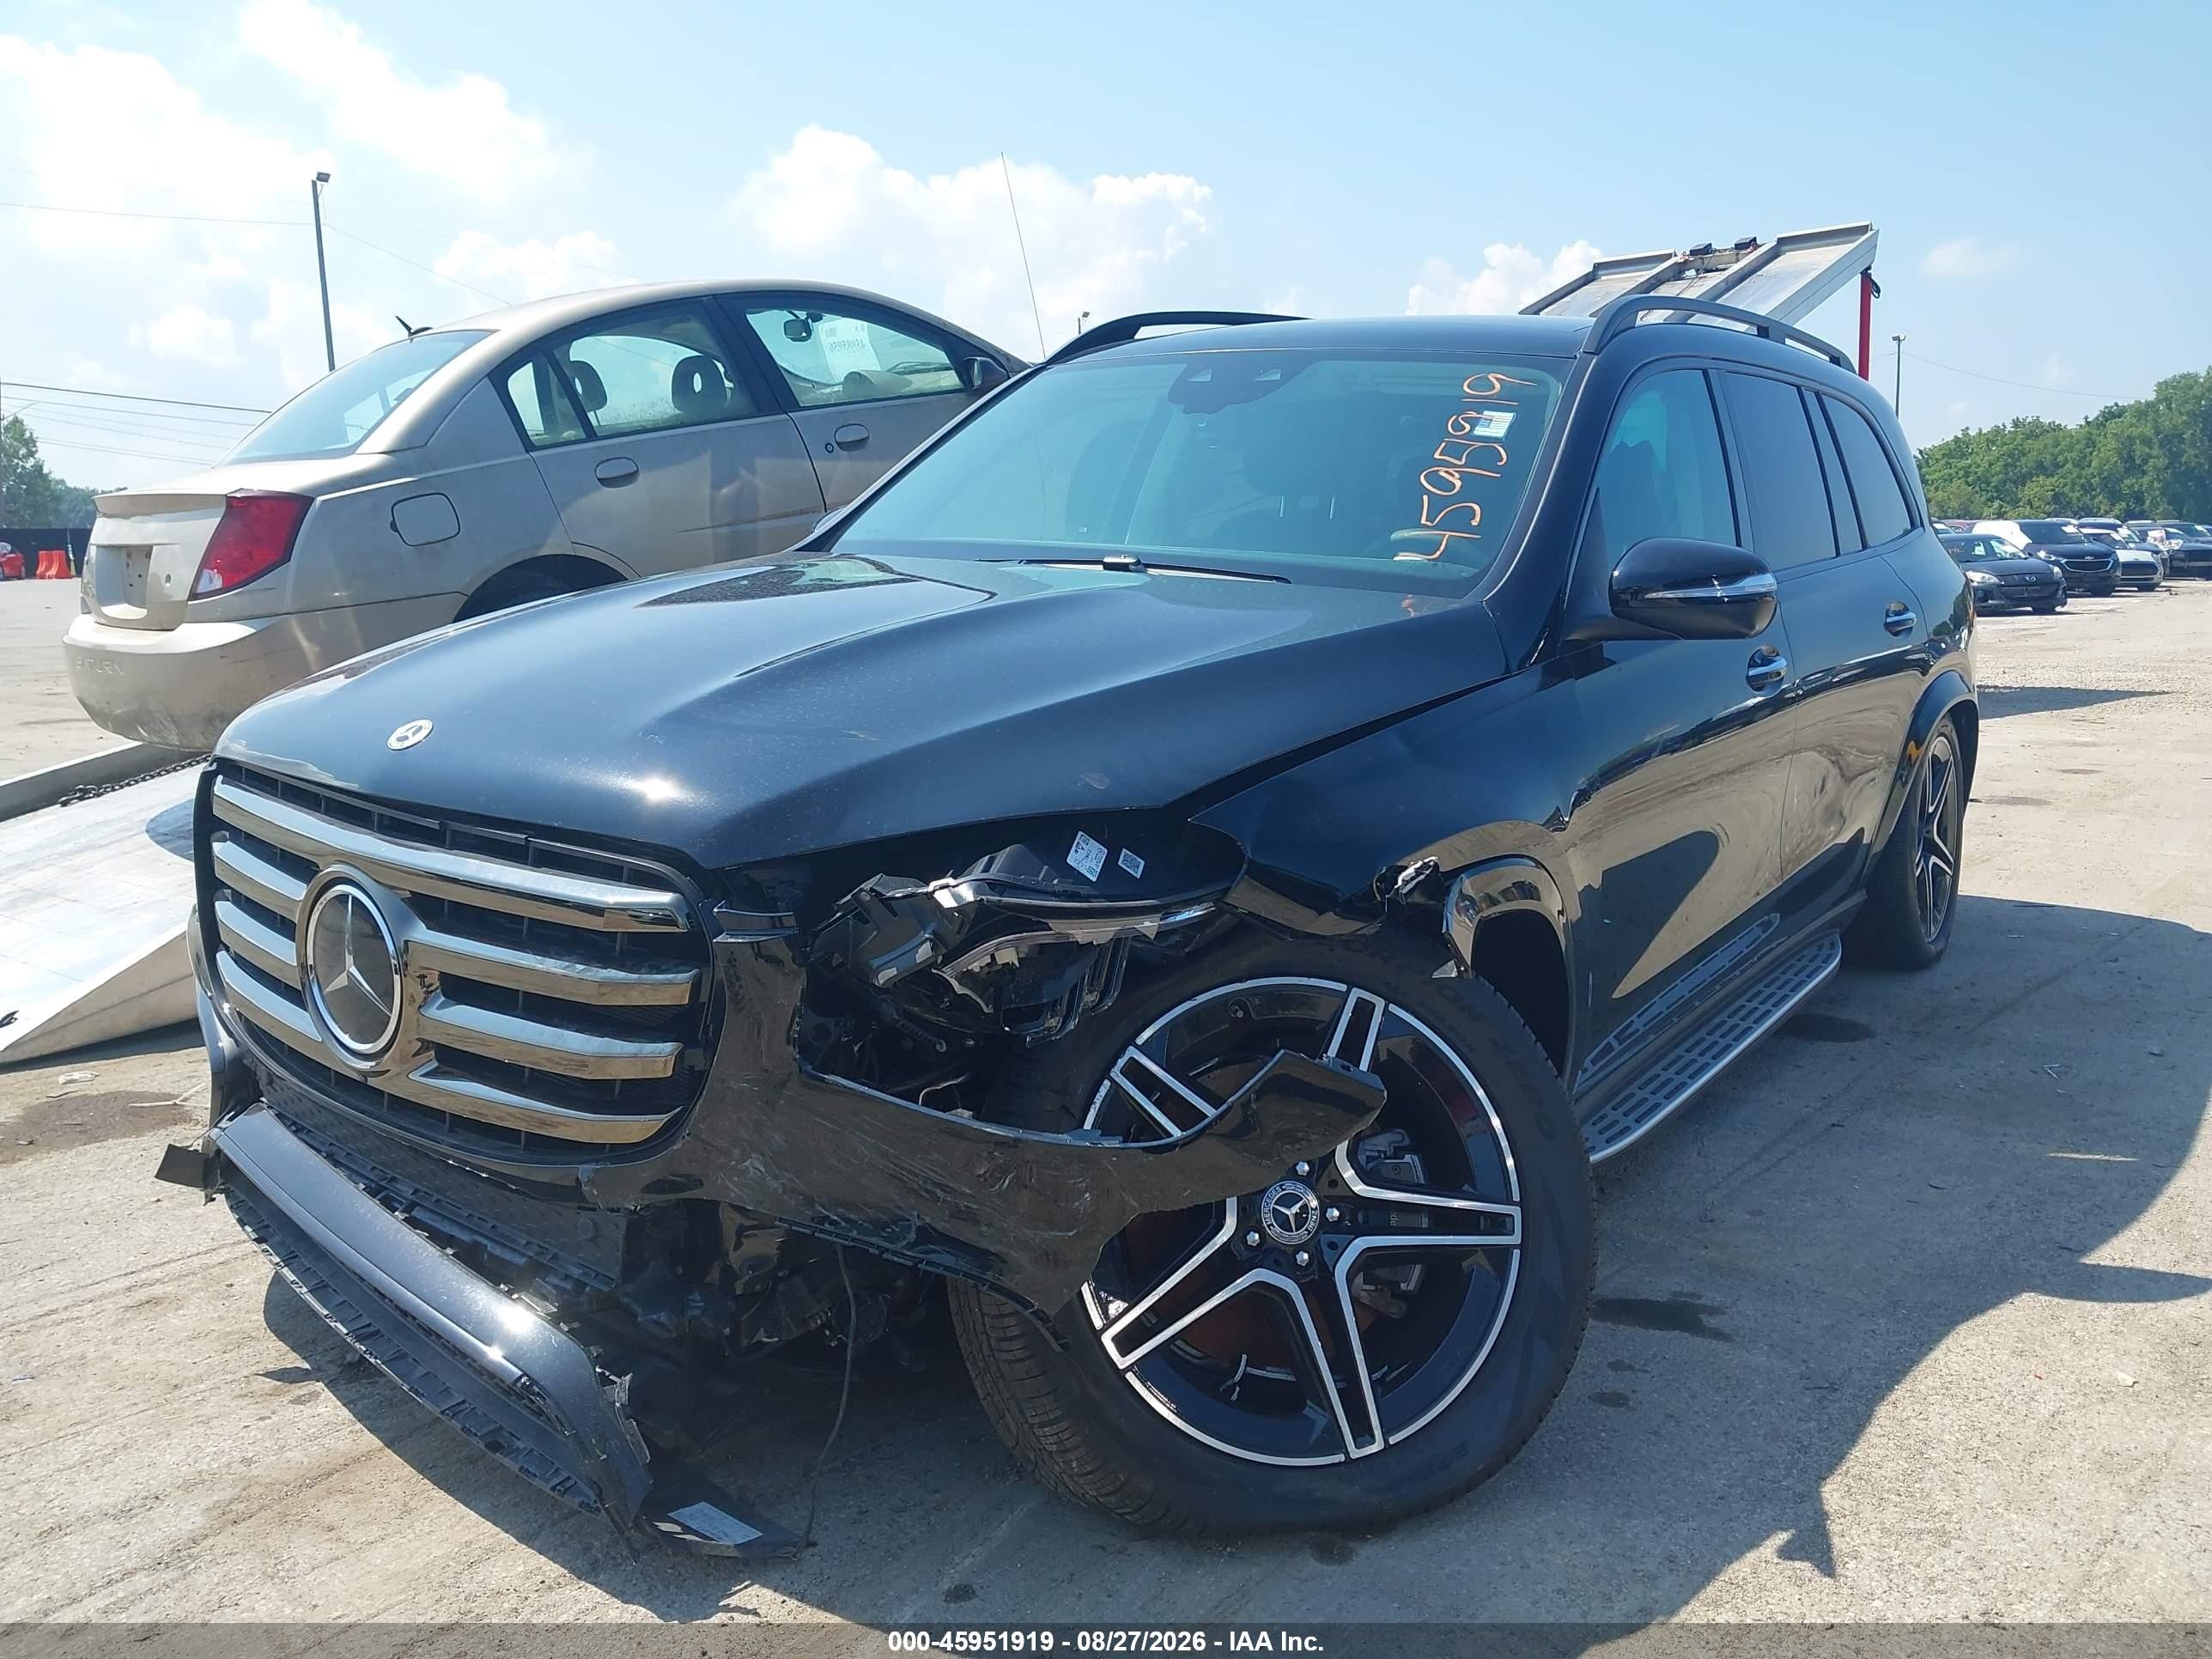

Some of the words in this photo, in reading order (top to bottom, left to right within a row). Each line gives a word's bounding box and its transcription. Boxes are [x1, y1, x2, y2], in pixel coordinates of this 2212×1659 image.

[1394, 372, 1538, 561] 45951919
[1263, 1185, 1282, 1225] MERCEDES
[1308, 1209, 1318, 1232] BENZ
